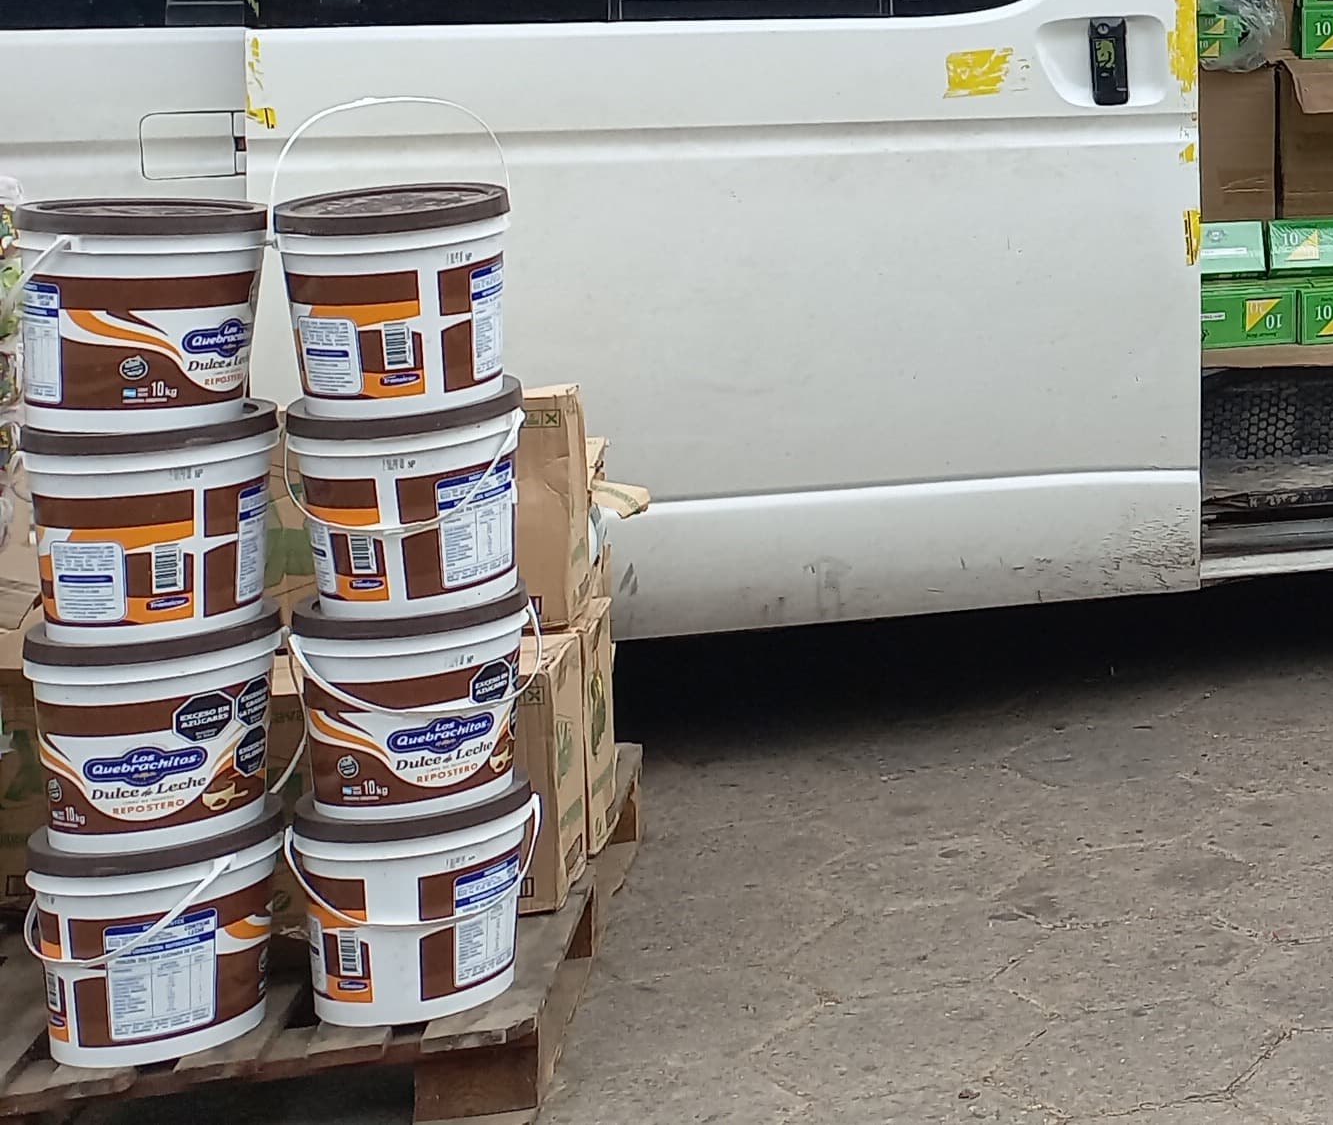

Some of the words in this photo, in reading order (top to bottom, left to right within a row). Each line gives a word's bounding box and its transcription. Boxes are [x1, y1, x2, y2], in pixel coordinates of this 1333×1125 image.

[1314, 21, 1331, 37] 10
[1281, 231, 1299, 246] 10
[1266, 313, 1283, 329] 10
[1315, 305, 1333, 321] 10
[223, 325, 238, 334] Los
[187, 357, 226, 372] Dulce
[204, 373, 245, 386] REPOSTER
[180, 707, 216, 722] EXCESO
[217, 705, 230, 714] EN
[396, 720, 488, 747] Quebrachitos
[435, 720, 456, 731] Los
[132, 753, 155, 764] Los
[395, 755, 442, 772] Dulce
[455, 740, 494, 761] Leche
[92, 754, 198, 775] Quebrachitos
[416, 762, 478, 783] REPOSTERO
[91, 786, 140, 801] Dulce
[157, 776, 207, 794] Leche
[112, 798, 186, 815] REPOSTERO
